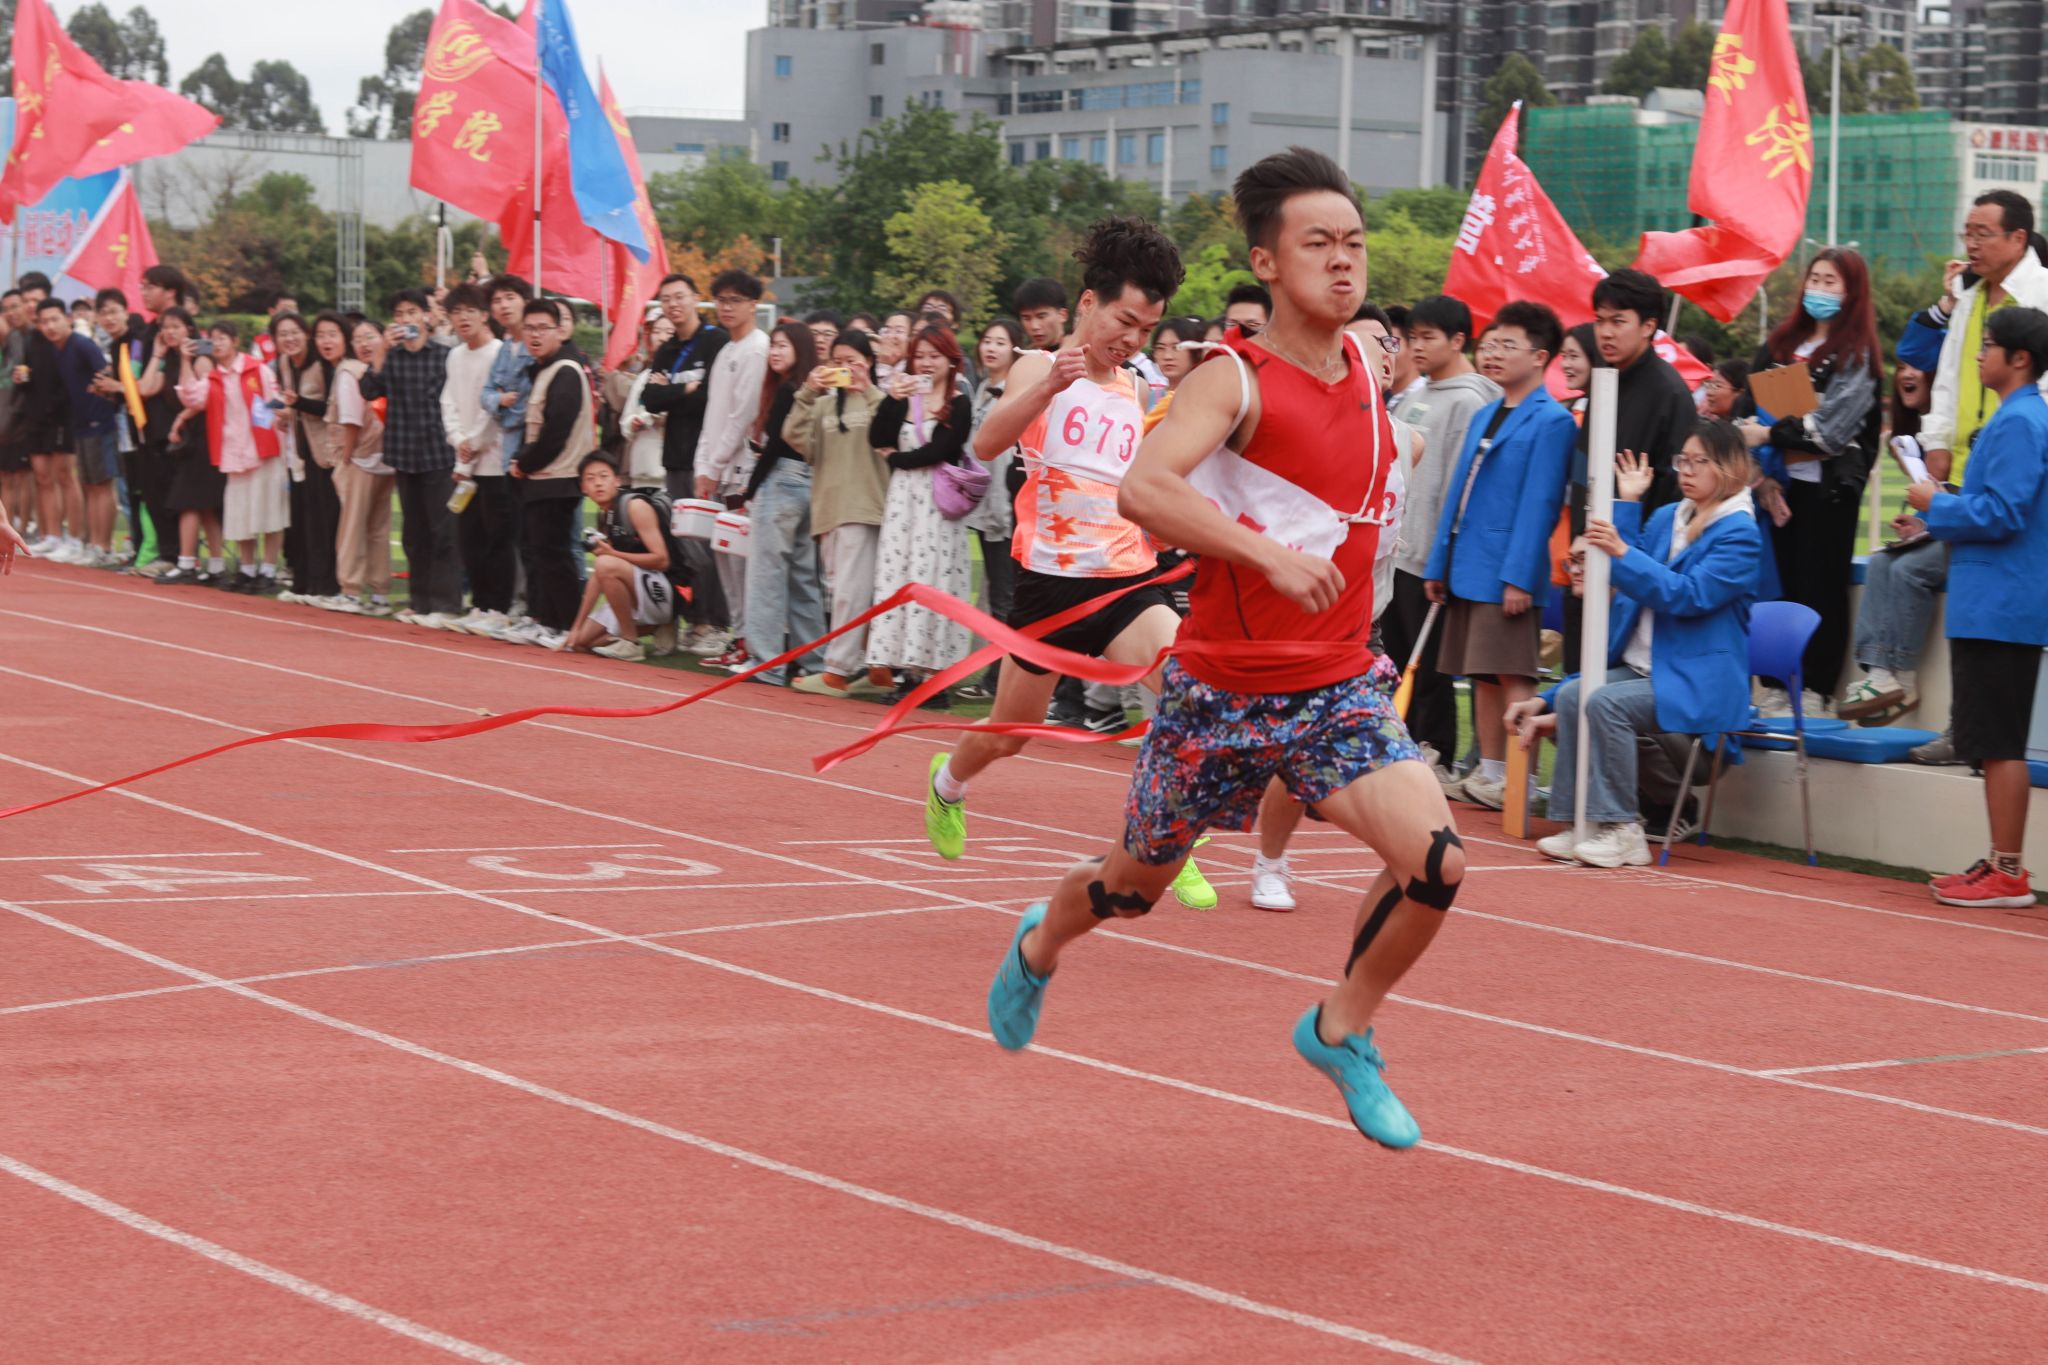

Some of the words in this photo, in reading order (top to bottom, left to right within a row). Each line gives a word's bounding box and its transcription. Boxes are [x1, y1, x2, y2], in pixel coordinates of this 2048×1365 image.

[416, 90, 502, 162] 学院
[1063, 405, 1135, 462] 673
[466, 855, 722, 881] 3
